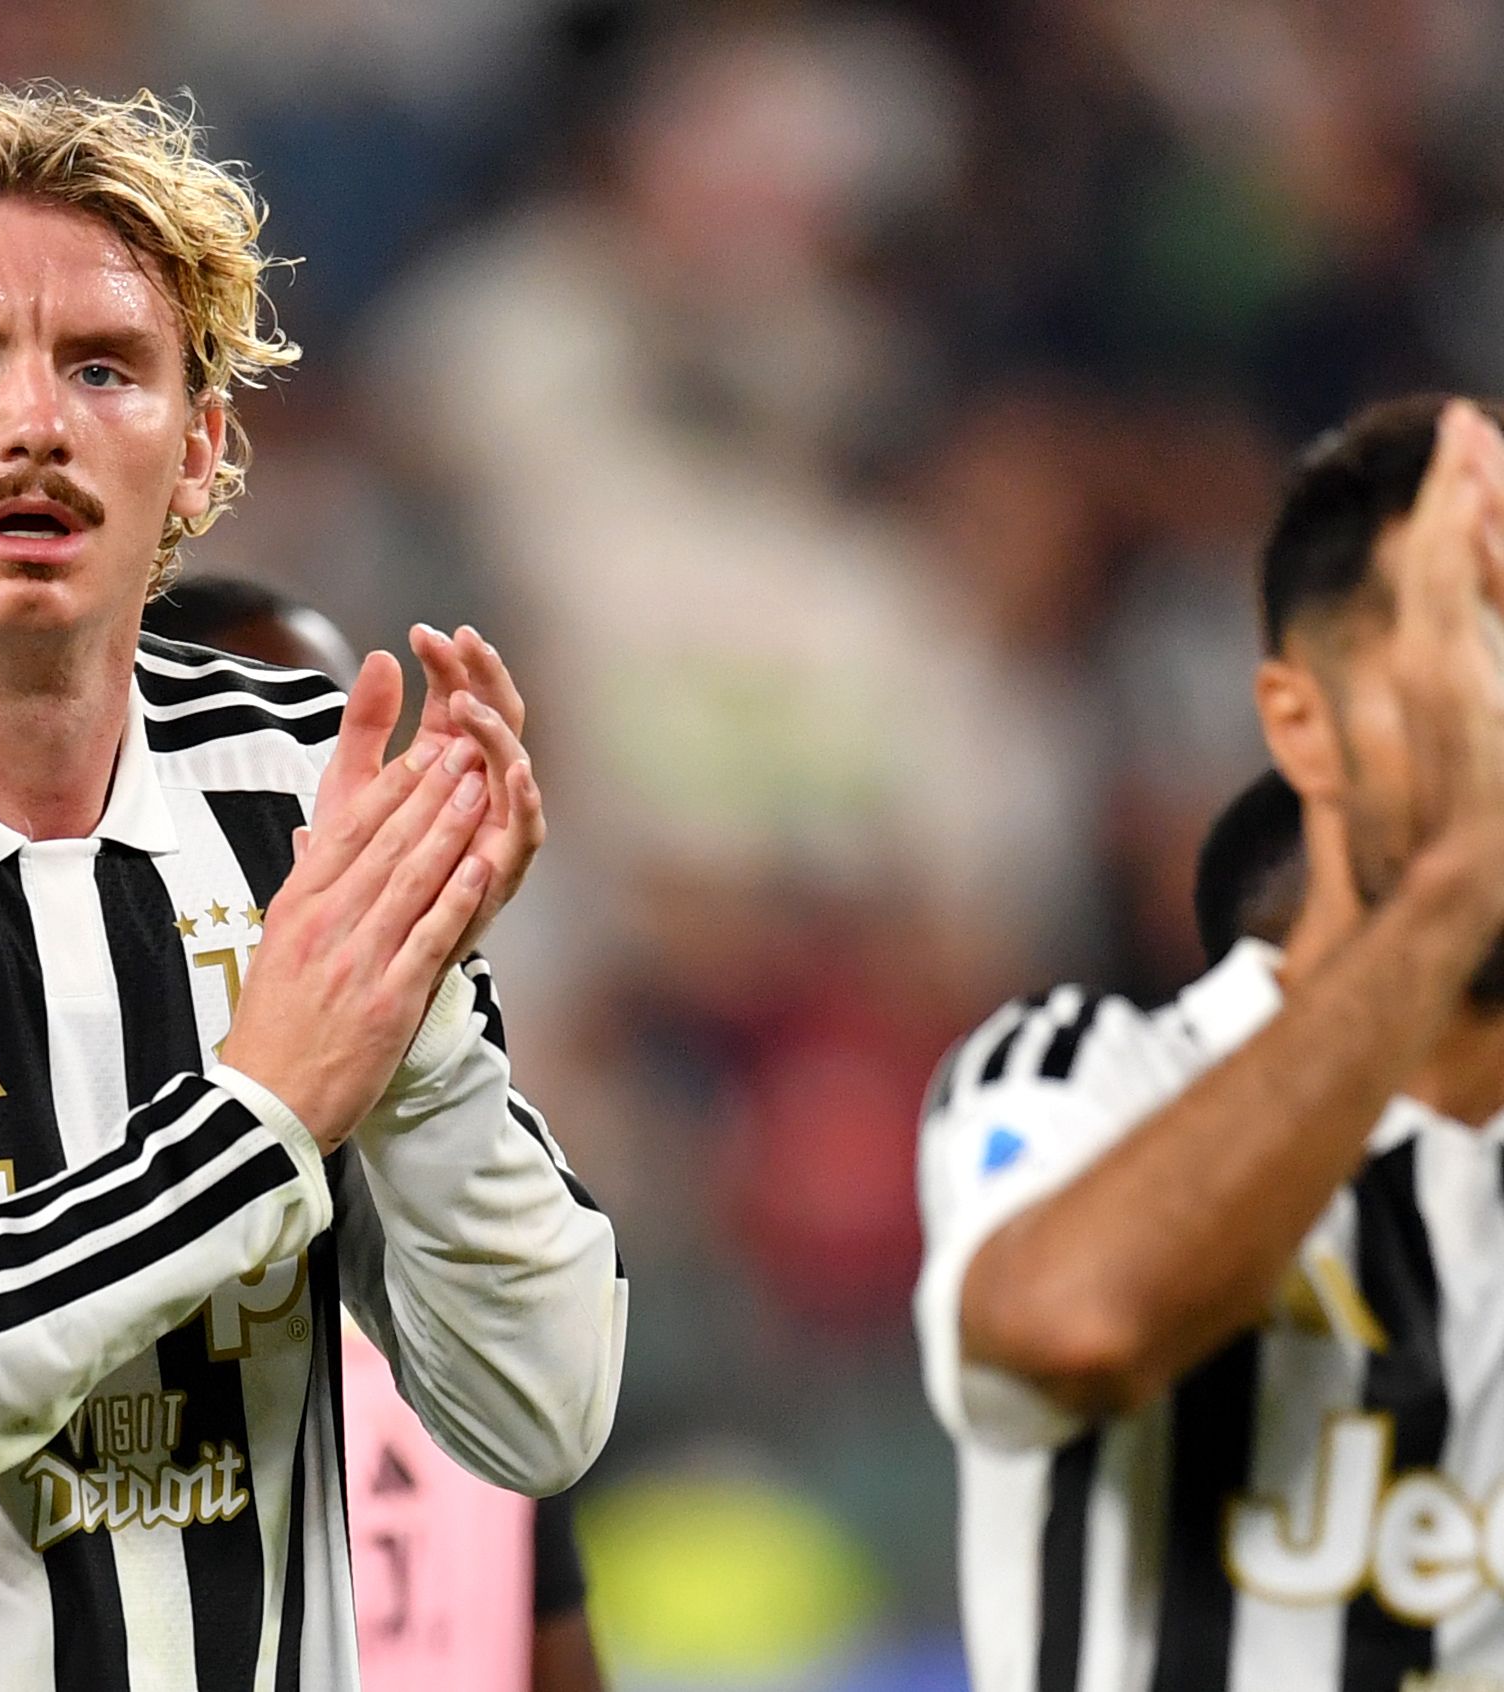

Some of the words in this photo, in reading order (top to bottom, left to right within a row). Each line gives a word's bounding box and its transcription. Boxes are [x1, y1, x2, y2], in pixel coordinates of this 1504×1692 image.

[67, 1389, 188, 1460] VISIT
[19, 1438, 251, 1552] Detroit
[1224, 1410, 1504, 1627] Je
